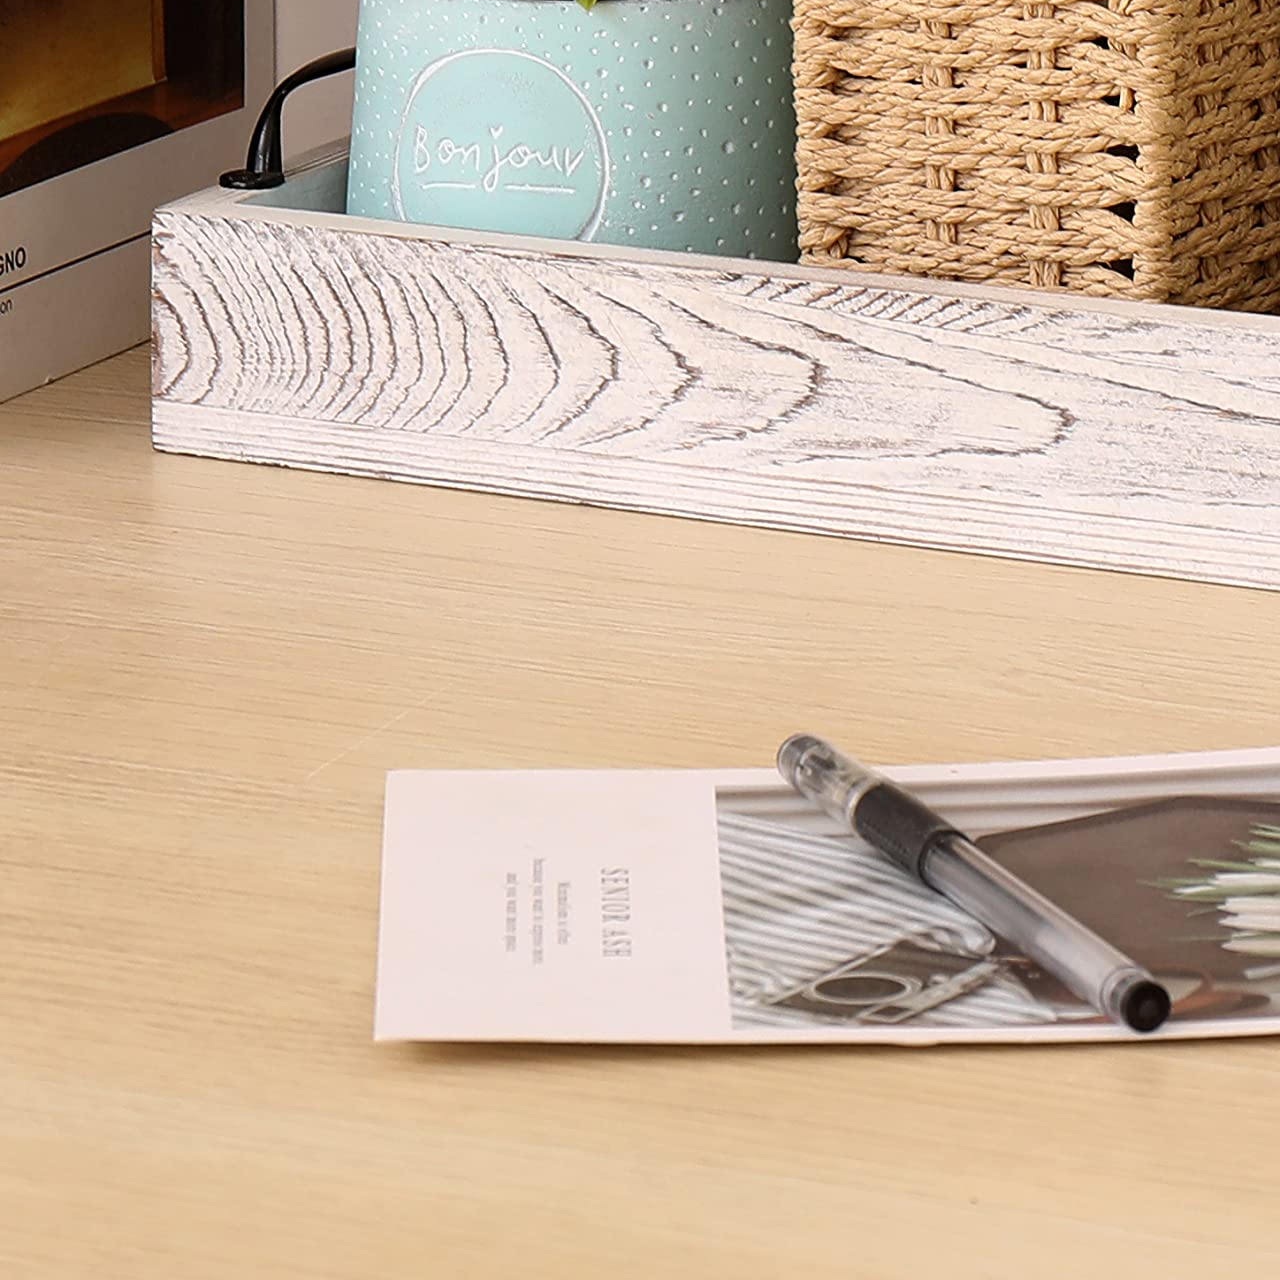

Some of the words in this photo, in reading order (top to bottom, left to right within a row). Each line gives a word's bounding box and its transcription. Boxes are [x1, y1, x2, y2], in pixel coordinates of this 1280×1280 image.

[412, 125, 585, 193] Bonjour
[601, 868, 631, 922] SENIOR
[602, 928, 632, 958] ASH
